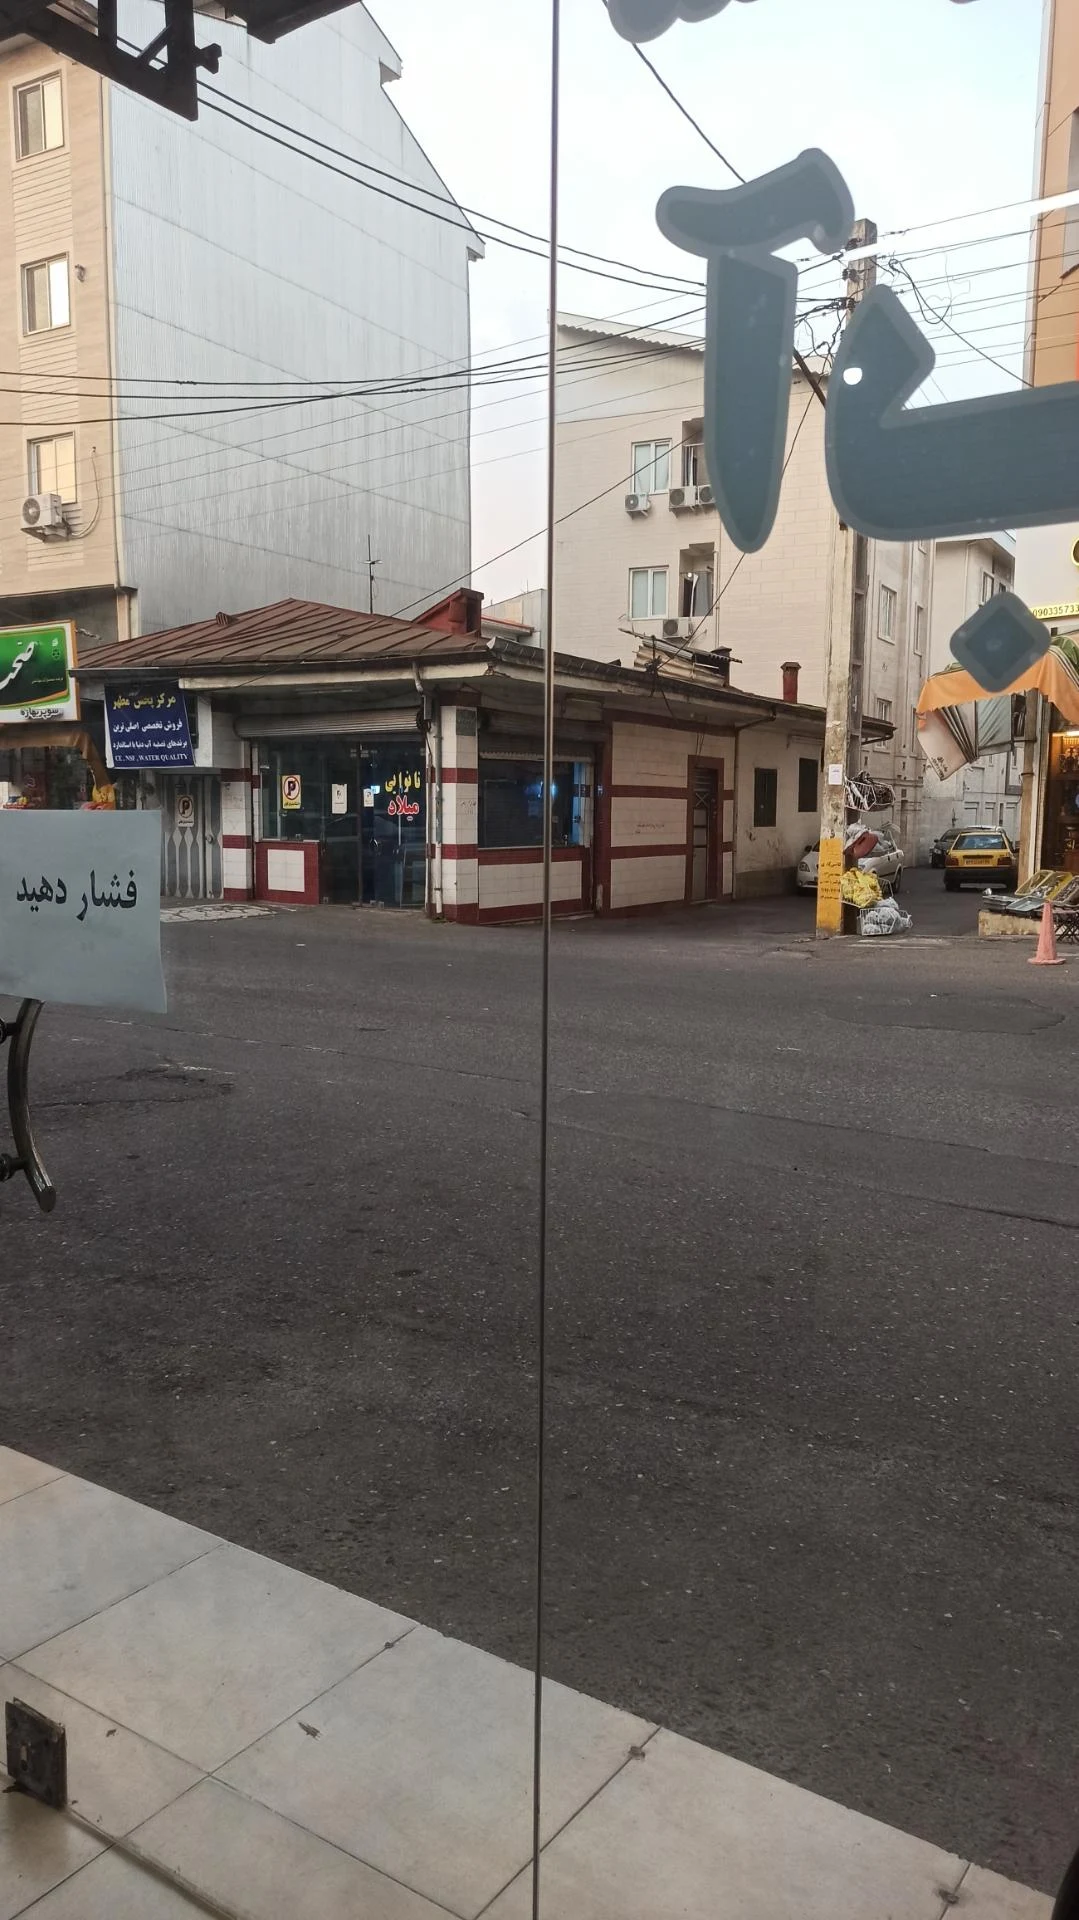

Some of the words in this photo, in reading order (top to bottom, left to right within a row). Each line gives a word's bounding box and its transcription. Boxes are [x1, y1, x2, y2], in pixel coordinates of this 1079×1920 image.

[156, 692, 177, 709] مرکز
[125, 721, 139, 732] اصلی
[141, 720, 163, 732] تخصصی
[164, 718, 183, 731] فروش
[144, 739, 152, 749] آب
[160, 753, 188, 762] QUALITY
[387, 795, 420, 821] میلاد
[16, 876, 67, 913] دهید
[76, 869, 138, 922] فشار
